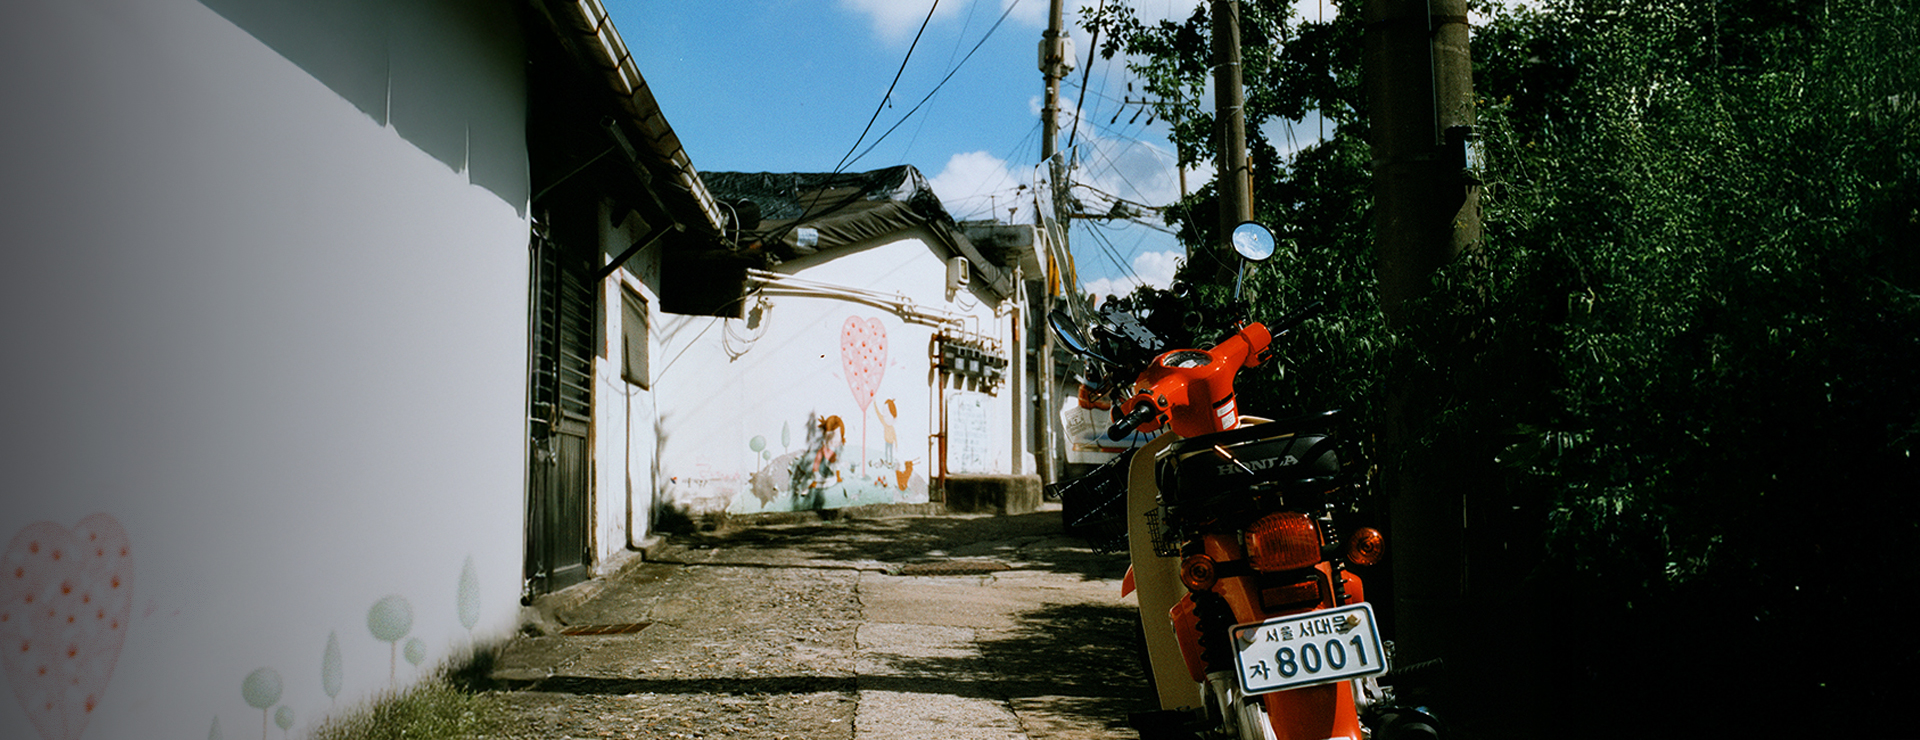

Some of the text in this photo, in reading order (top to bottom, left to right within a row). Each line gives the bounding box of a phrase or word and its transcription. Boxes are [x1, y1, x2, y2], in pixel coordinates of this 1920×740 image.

[1266, 615, 1348, 642] 서울 서대문
[1250, 634, 1367, 679] 자 8001
